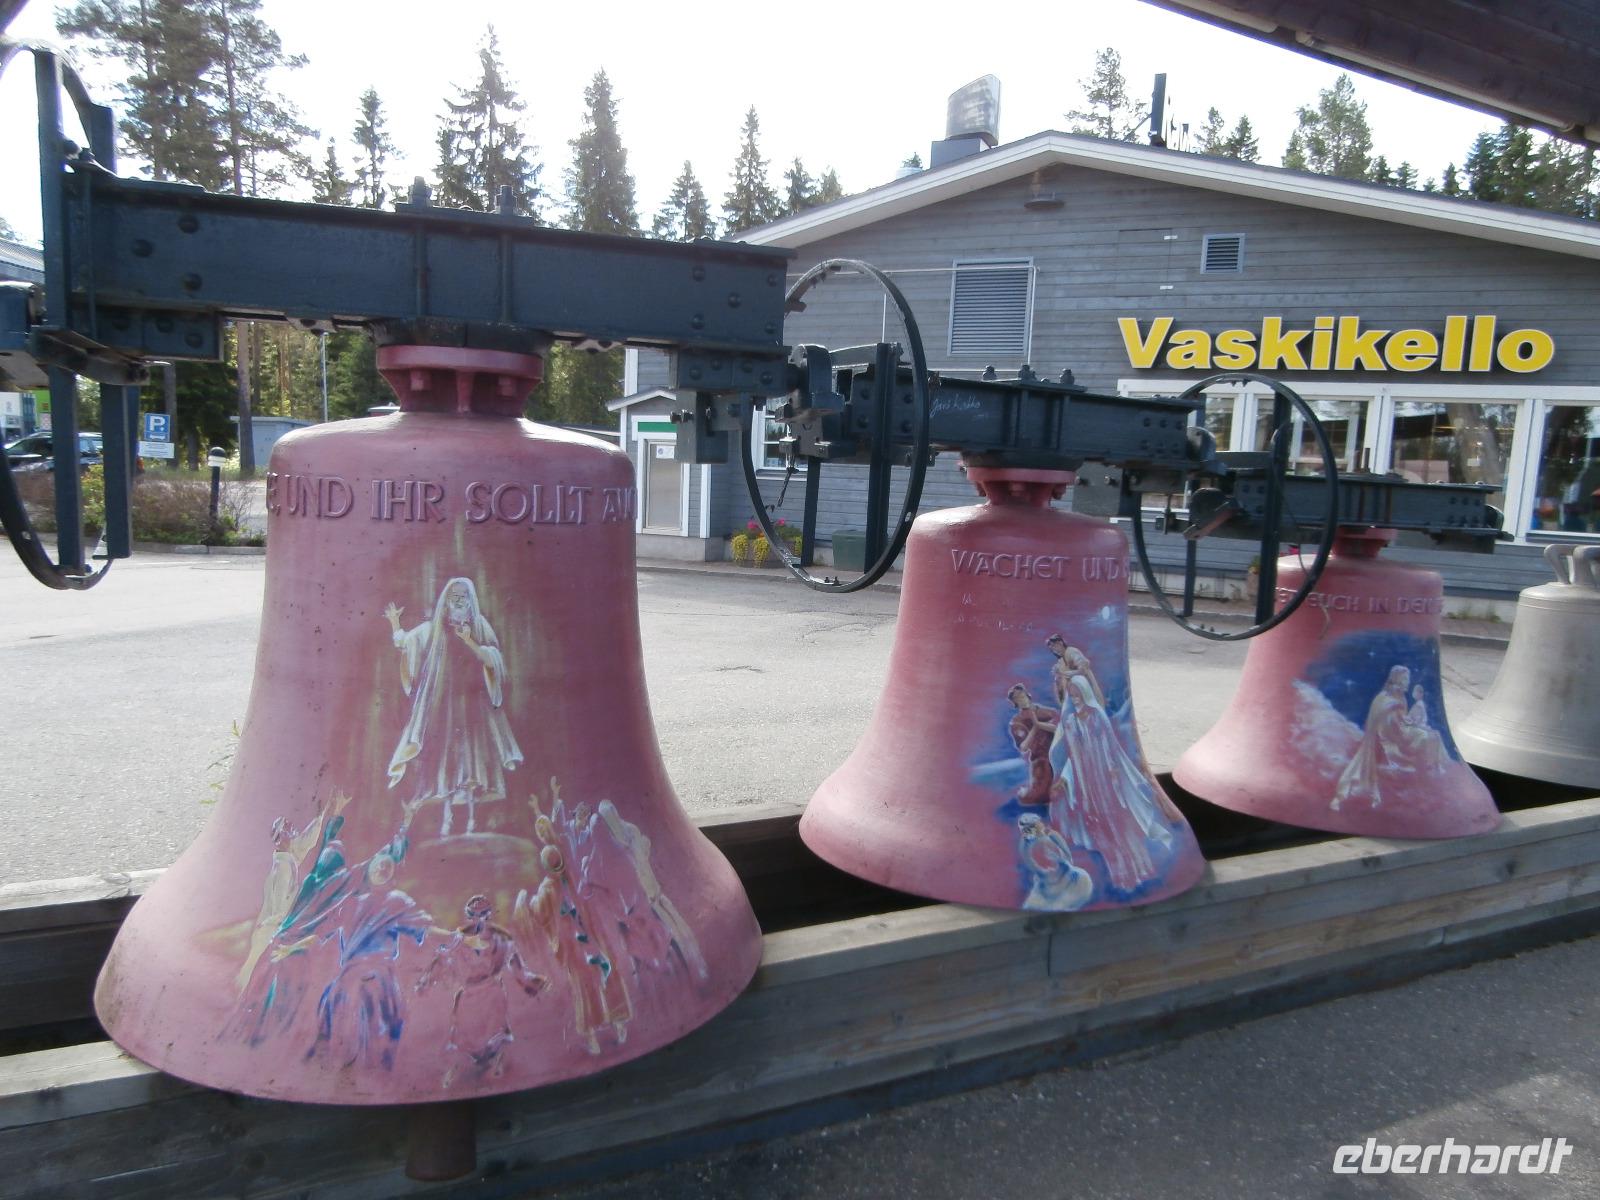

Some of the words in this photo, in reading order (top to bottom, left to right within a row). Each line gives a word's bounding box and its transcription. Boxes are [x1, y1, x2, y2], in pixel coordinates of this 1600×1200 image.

[1117, 315, 1555, 373] Vaskikello
[150, 416, 165, 431] P
[285, 474, 354, 519] UND
[370, 479, 445, 523] IHR
[464, 480, 592, 525] SOLLT
[951, 549, 1071, 581] WACHET
[1368, 597, 1391, 614] IN
